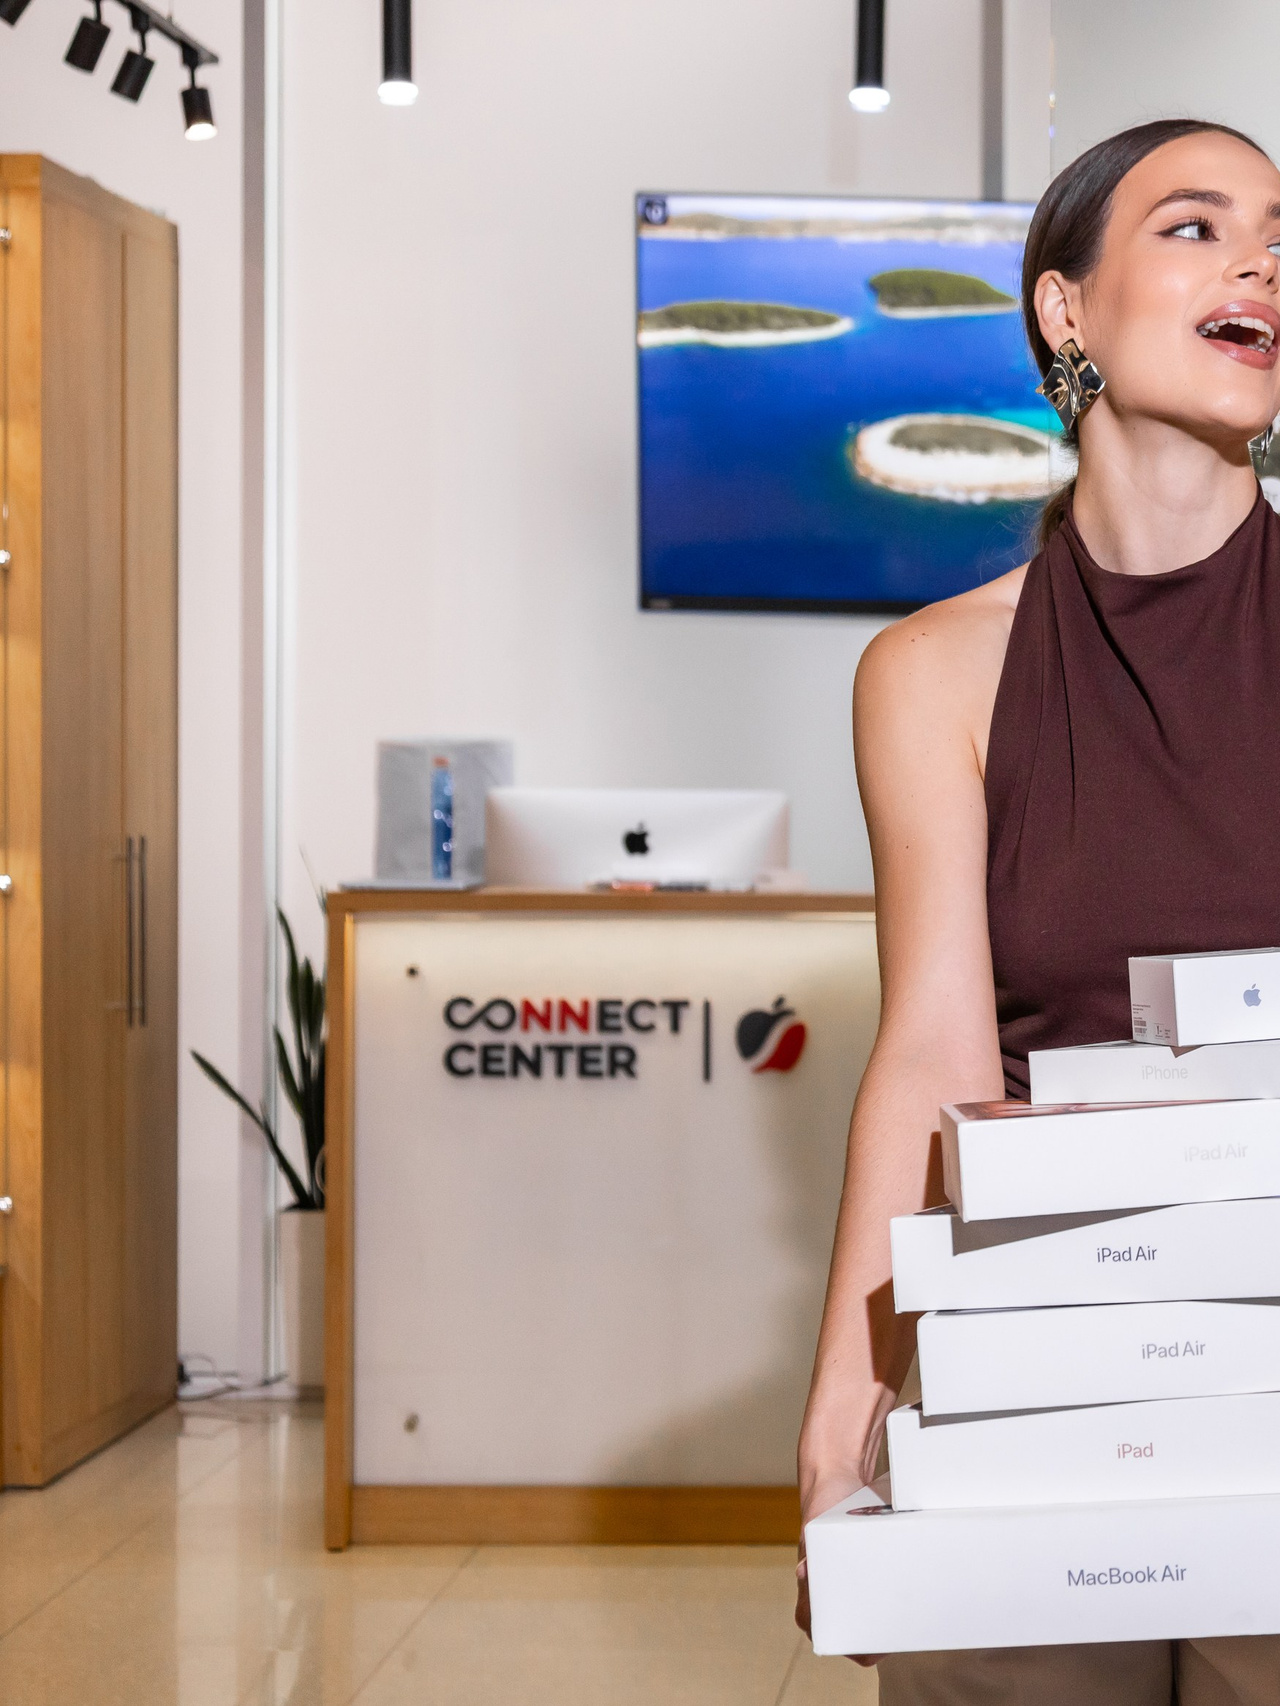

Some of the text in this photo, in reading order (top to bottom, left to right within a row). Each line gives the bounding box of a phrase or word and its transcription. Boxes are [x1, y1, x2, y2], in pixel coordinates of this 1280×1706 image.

[443, 996, 690, 1034] CONNECT
[443, 1043, 638, 1079] CENTER
[1141, 1065, 1188, 1080] iPhone
[1184, 1142, 1249, 1163] iPad Air
[1096, 1245, 1157, 1263] iPad Air
[1141, 1340, 1206, 1360] iPad Air
[1117, 1442, 1154, 1459] iPad
[1067, 1564, 1187, 1587] MacBook Air
